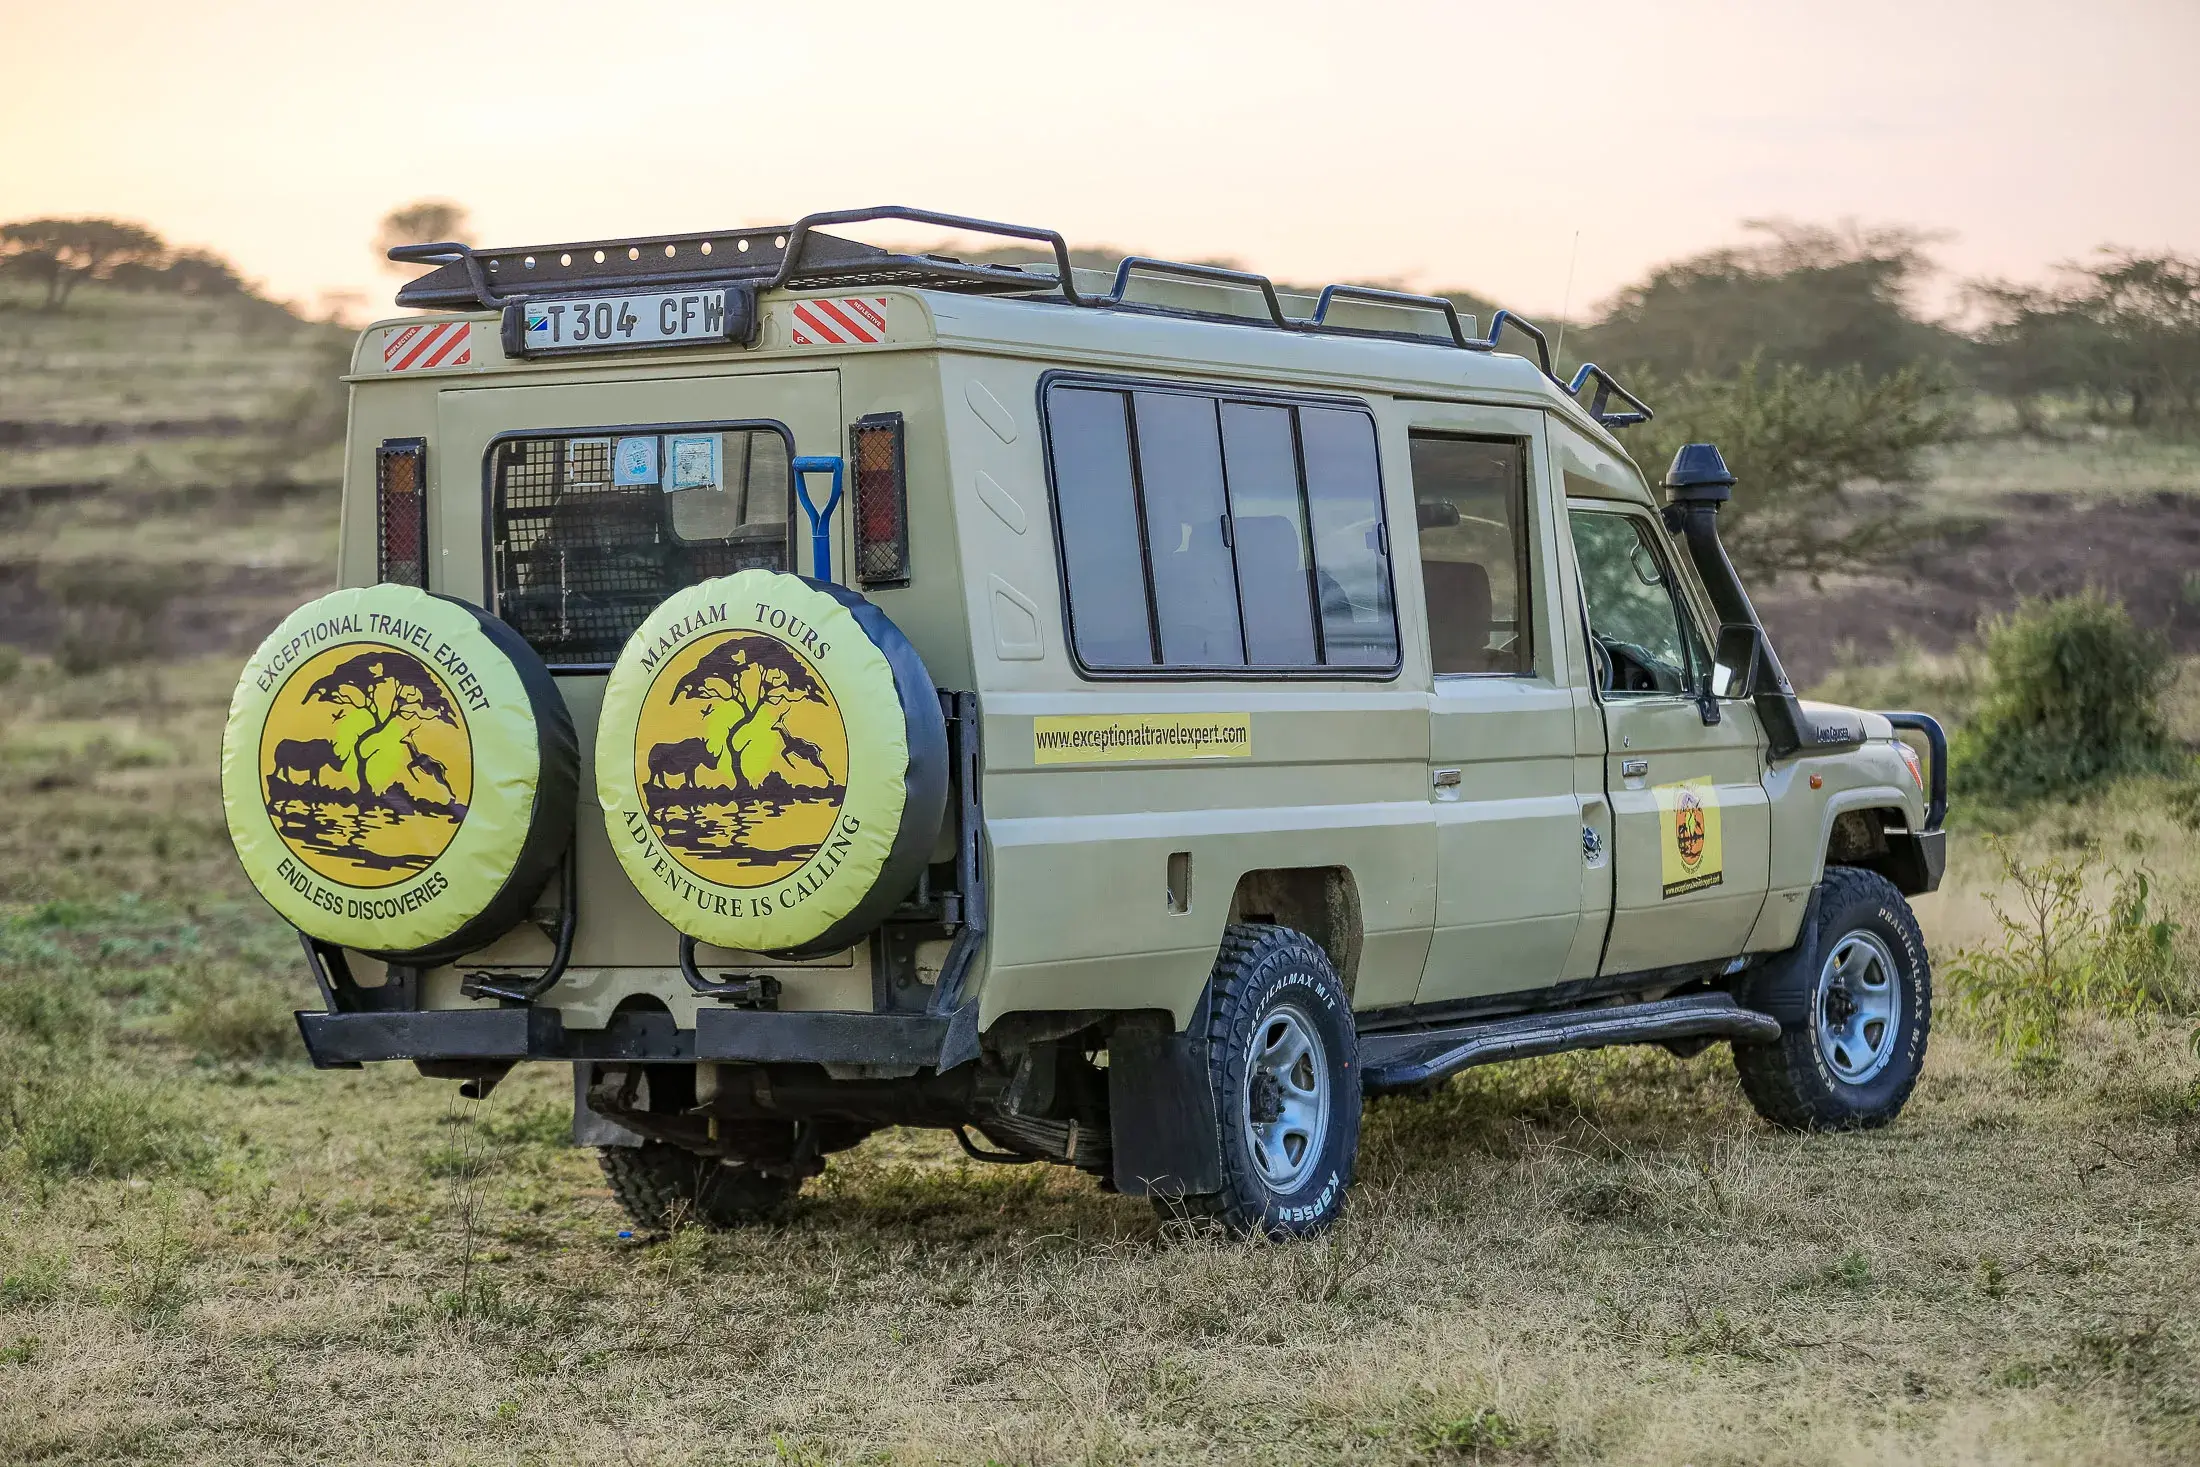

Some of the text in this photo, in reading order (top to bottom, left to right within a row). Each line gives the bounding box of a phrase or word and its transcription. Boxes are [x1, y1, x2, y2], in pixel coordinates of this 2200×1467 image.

[659, 294, 722, 335] CFW
[853, 301, 882, 327] REFLECTIVE
[387, 328, 417, 358] REFLECTIVE
[256, 613, 491, 712] EXCEPTIONAL TRAVEL EXPERT
[640, 602, 832, 674] MARIAM TOURS
[1036, 723, 1247, 752] www.exceptionaltravelexpert.com
[276, 857, 449, 920] ENDLESS DISCOVERIES
[622, 808, 861, 918] ADVENTURE IS CALLING
[1878, 907, 1923, 1021] PRACTICALMAX
[1315, 982, 1336, 1010] M/T
